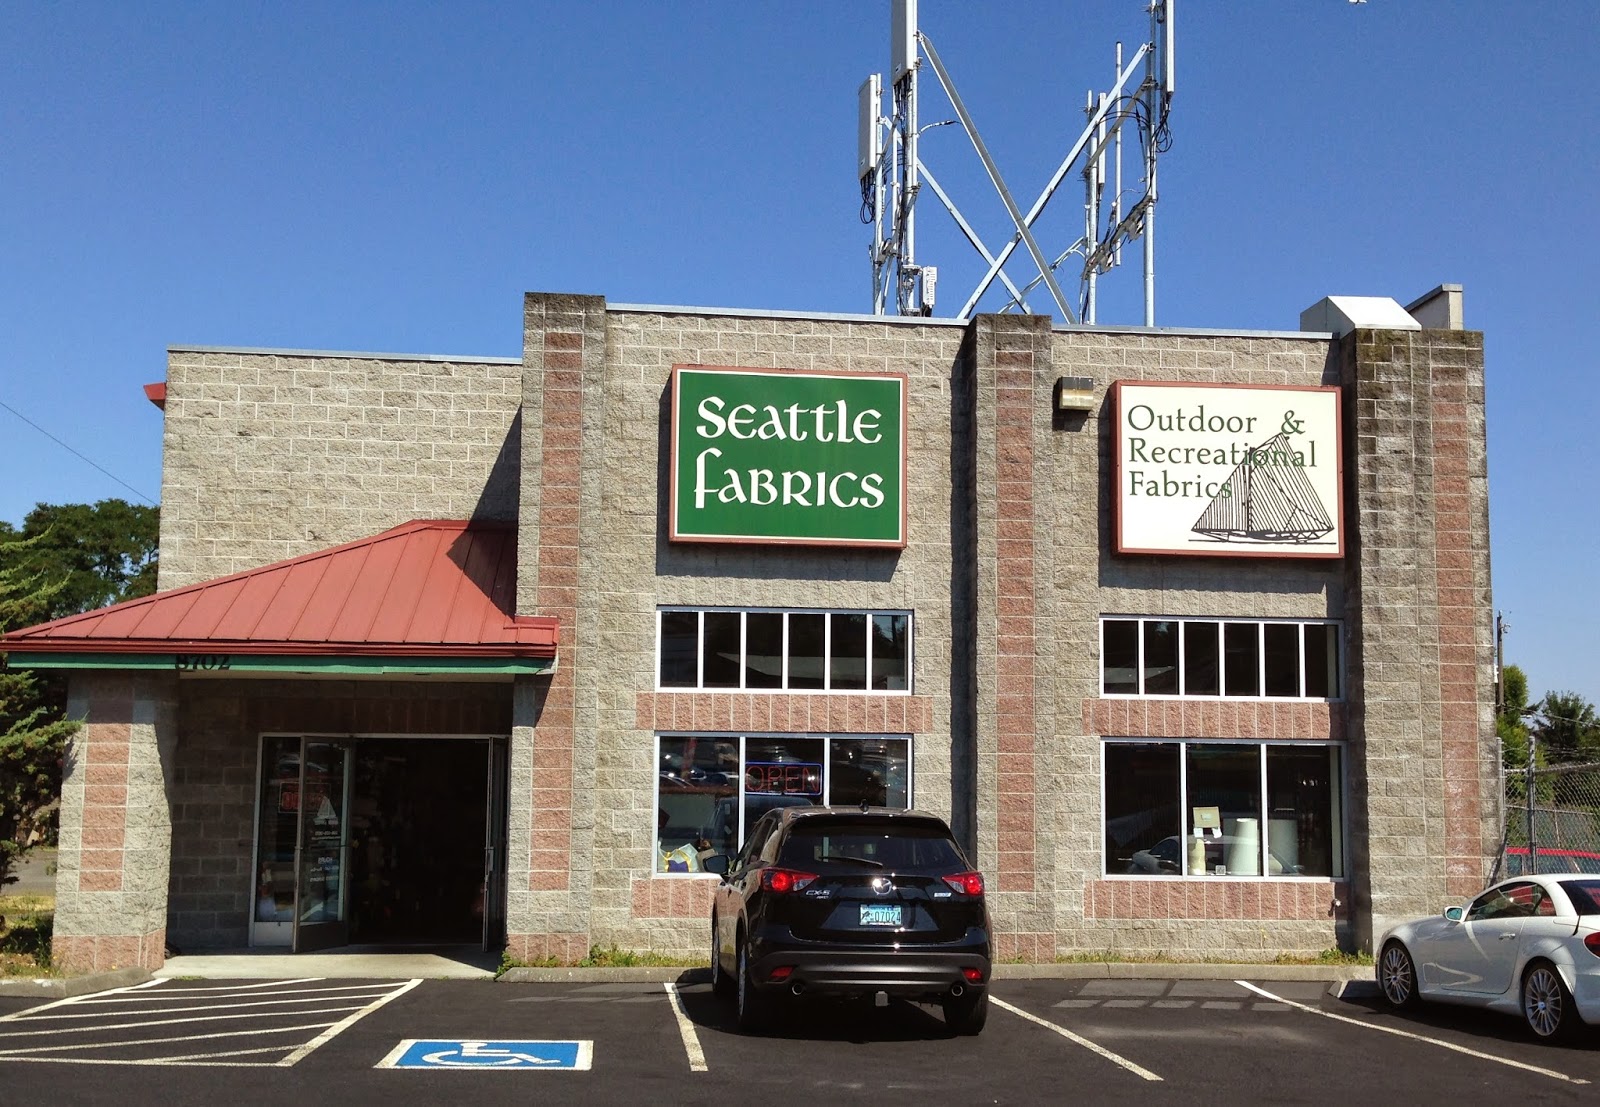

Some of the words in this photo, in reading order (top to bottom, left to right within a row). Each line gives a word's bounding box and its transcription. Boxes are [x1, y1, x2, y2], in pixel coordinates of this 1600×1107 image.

[1127, 404, 1257, 433] Outdoor
[1280, 409, 1306, 435] &
[1128, 437, 1318, 468] Recreational
[1129, 469, 1232, 499] Fabrics
[174, 654, 231, 670] 8702
[745, 765, 820, 792] OPEN
